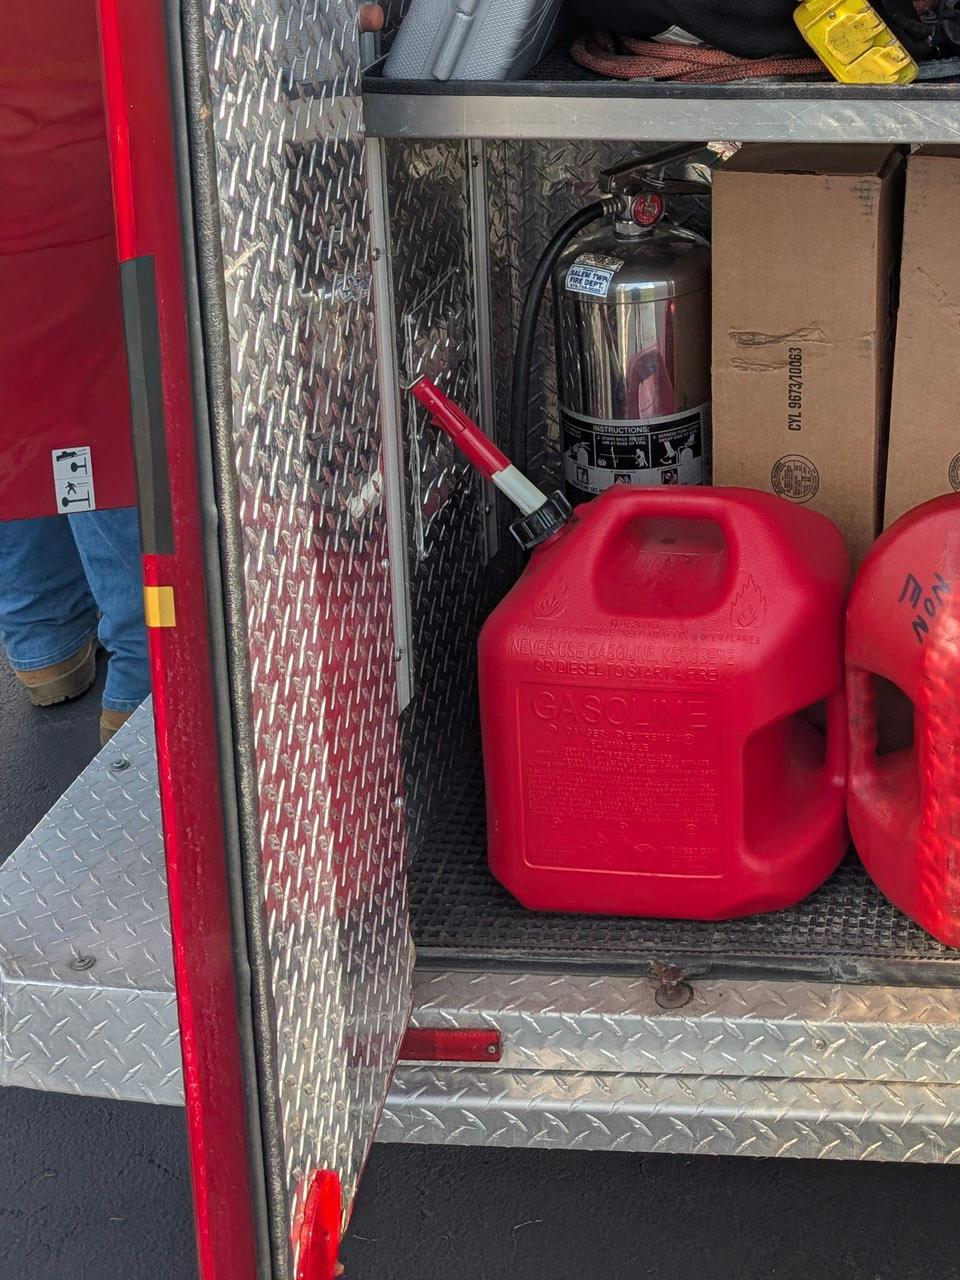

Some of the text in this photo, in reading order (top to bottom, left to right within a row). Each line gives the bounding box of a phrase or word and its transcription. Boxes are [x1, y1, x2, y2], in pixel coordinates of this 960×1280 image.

[570, 276, 584, 285] FIRE
[788, 347, 804, 410] 9673/10063
[788, 411, 802, 431] CYL
[512, 639, 555, 657] NEVER
[559, 641, 584, 658] USE
[535, 658, 554, 672] OR
[558, 660, 603, 676] DIESEL
[606, 661, 624, 677] TO
[628, 663, 671, 679] START
[533, 691, 707, 729] GASOLINE
